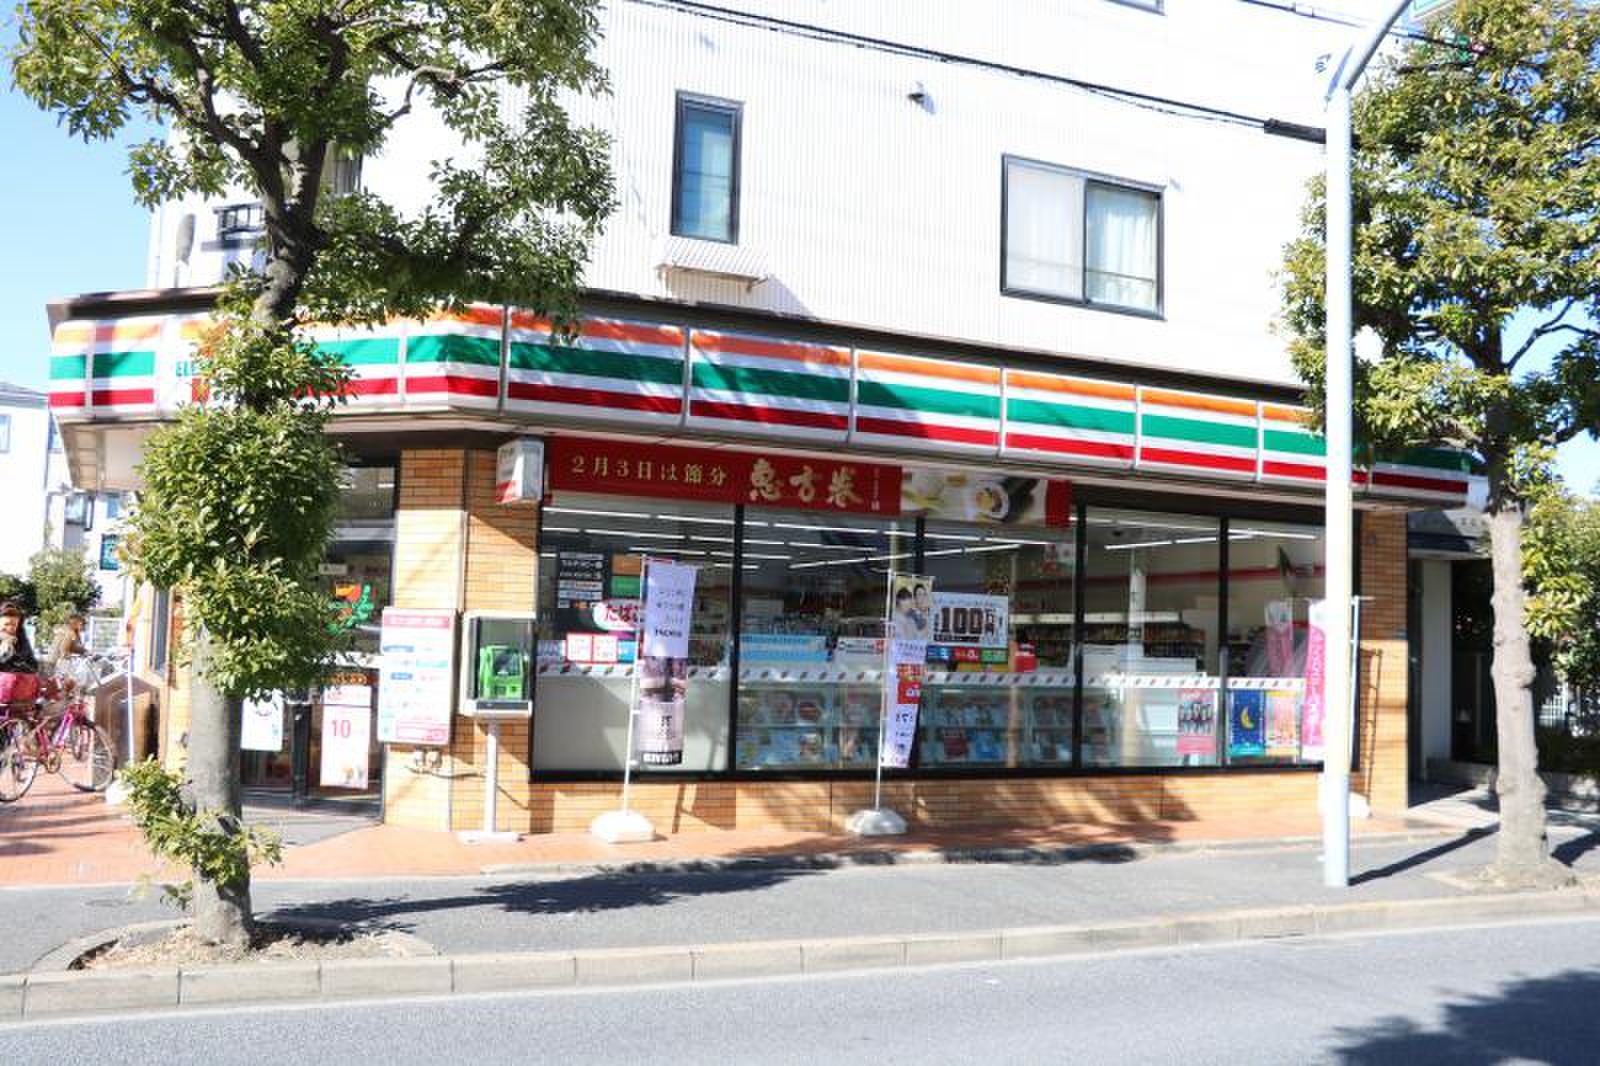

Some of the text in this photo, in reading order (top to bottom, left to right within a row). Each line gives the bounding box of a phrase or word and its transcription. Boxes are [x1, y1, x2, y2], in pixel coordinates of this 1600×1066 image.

[571, 454, 728, 487] 2月3日は節分
